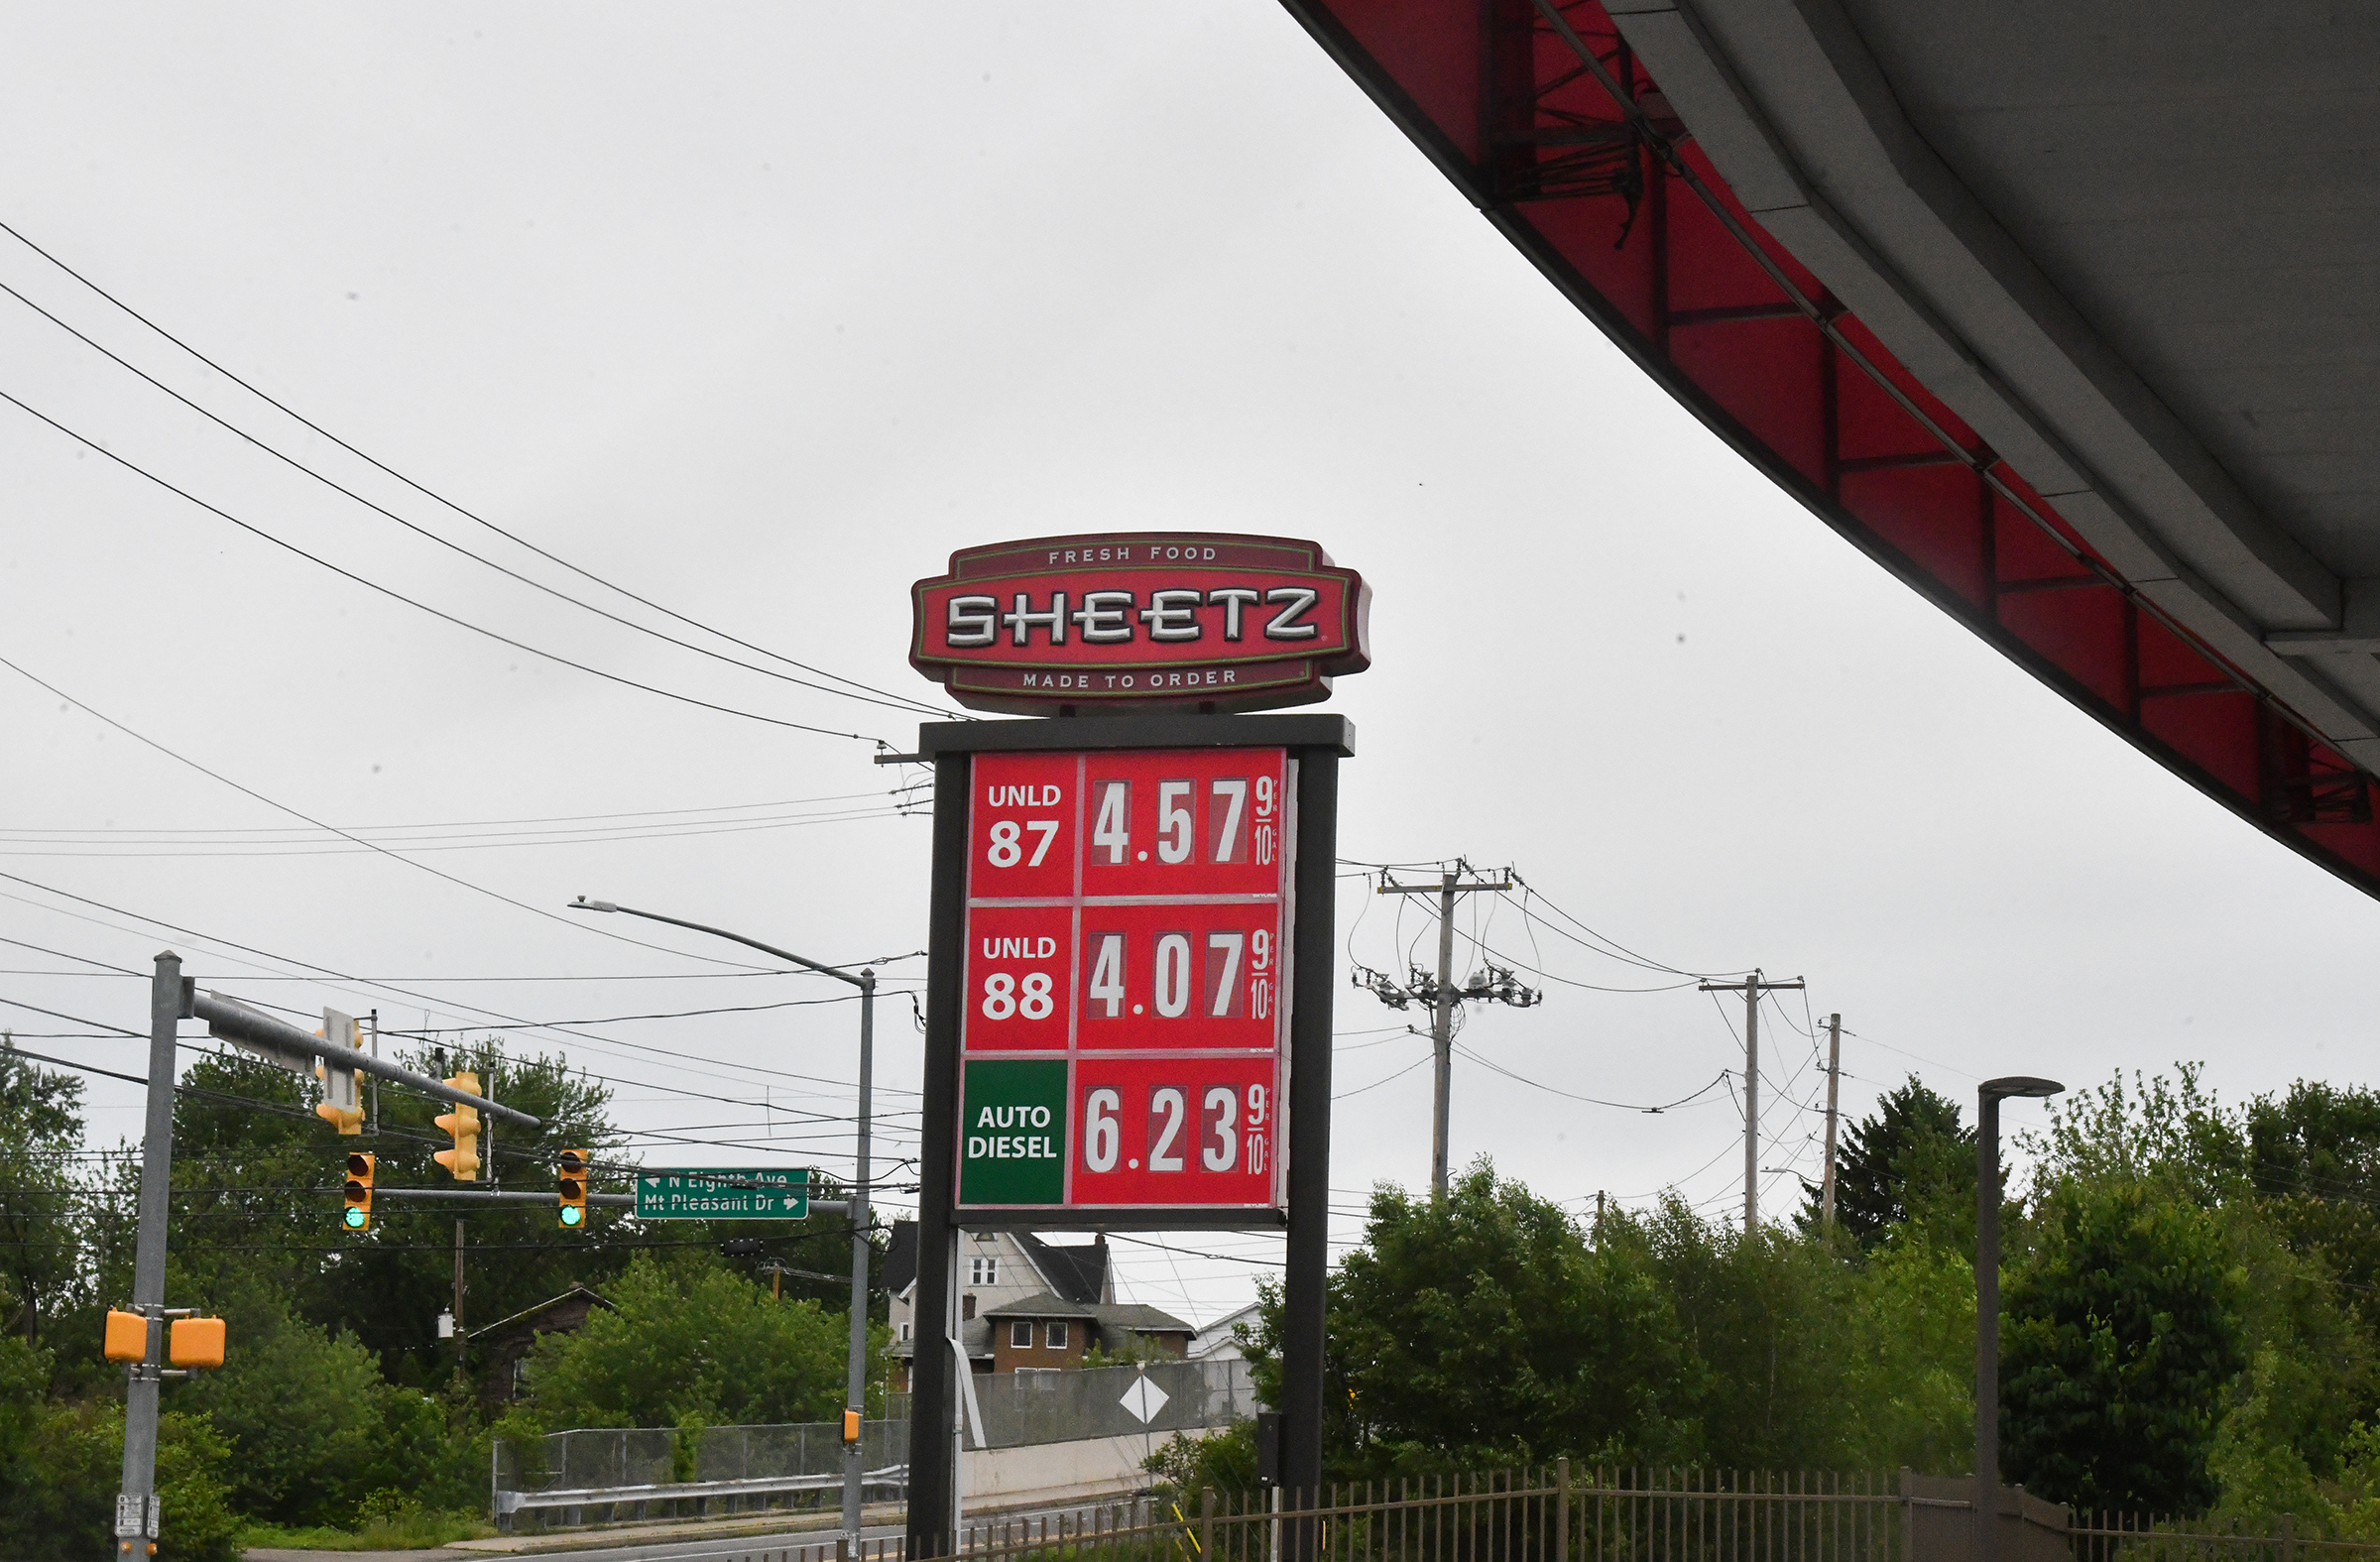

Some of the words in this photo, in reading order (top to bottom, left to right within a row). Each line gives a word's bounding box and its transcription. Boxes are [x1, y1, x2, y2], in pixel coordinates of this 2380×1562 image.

[1048, 547, 1130, 564] FRESH
[1150, 546, 1217, 560] FOOD
[946, 587, 1319, 648] SHEETZ
[1022, 673, 1089, 688] MADE
[1105, 674, 1134, 688] TO
[1150, 669, 1237, 687] ORDER
[988, 784, 1061, 806] UNLD
[1093, 781, 1247, 865] 4.57
[987, 820, 1060, 868] 87
[983, 936, 1056, 959] UNLD
[1090, 934, 1244, 1018] 4.07
[982, 972, 1054, 1021] 88
[977, 1106, 1051, 1129] AUTO
[1084, 1087, 1239, 1173] 6.23
[968, 1136, 1057, 1158] DIESEL
[668, 1175, 680, 1188] N
[645, 1194, 664, 1211] Mt
[670, 1194, 749, 1211] Pleasant
[755, 1194, 774, 1211] Dr
